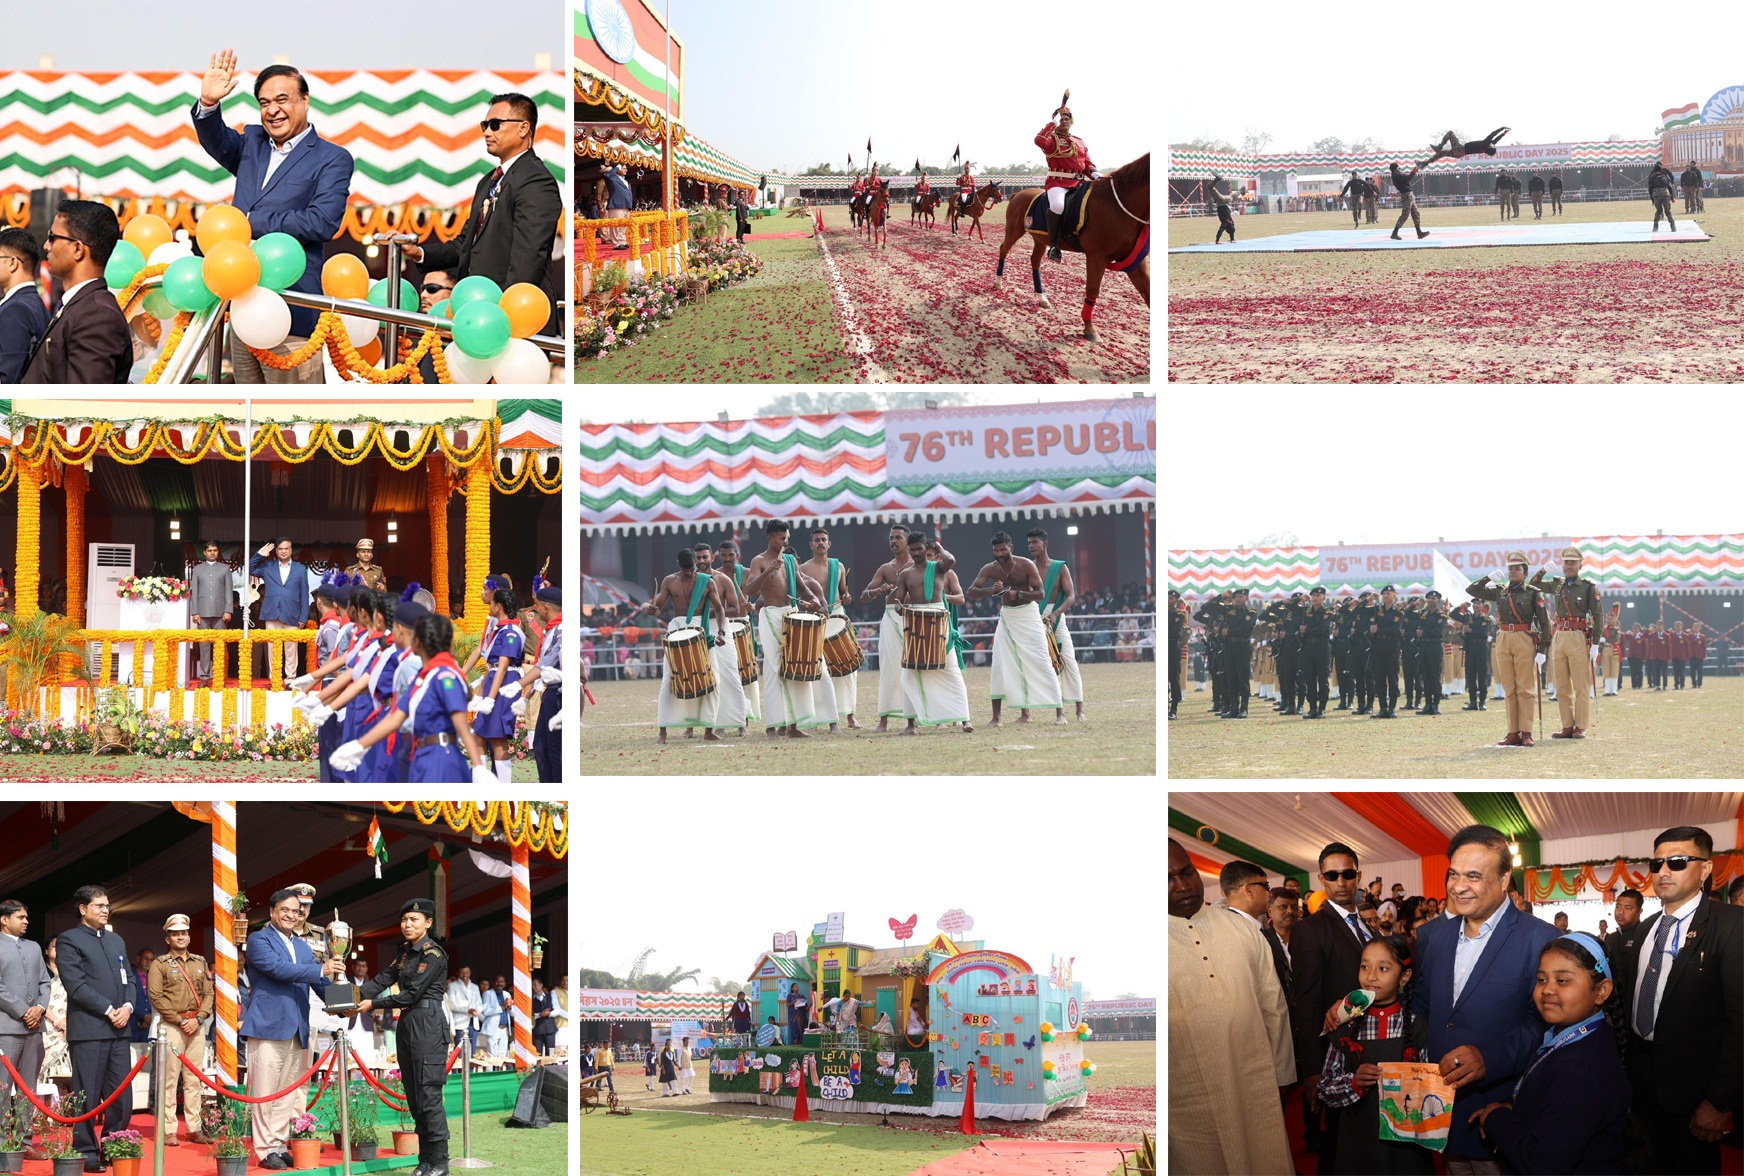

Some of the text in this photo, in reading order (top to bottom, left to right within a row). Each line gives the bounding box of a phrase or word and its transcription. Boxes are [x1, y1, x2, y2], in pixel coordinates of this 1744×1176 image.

[1525, 149, 1543, 158] DAY
[1546, 148, 1569, 156] 2025
[899, 429, 973, 463] 76TH
[1325, 556, 1362, 573] 76TH
[1366, 551, 1465, 572] REPUBIC
[1519, 548, 1562, 567] 025
[821, 1050, 847, 1063] LET A
[823, 1065, 849, 1075] CHILD
[823, 1076, 843, 1087] BE A
[822, 1088, 848, 1098] CHILD
